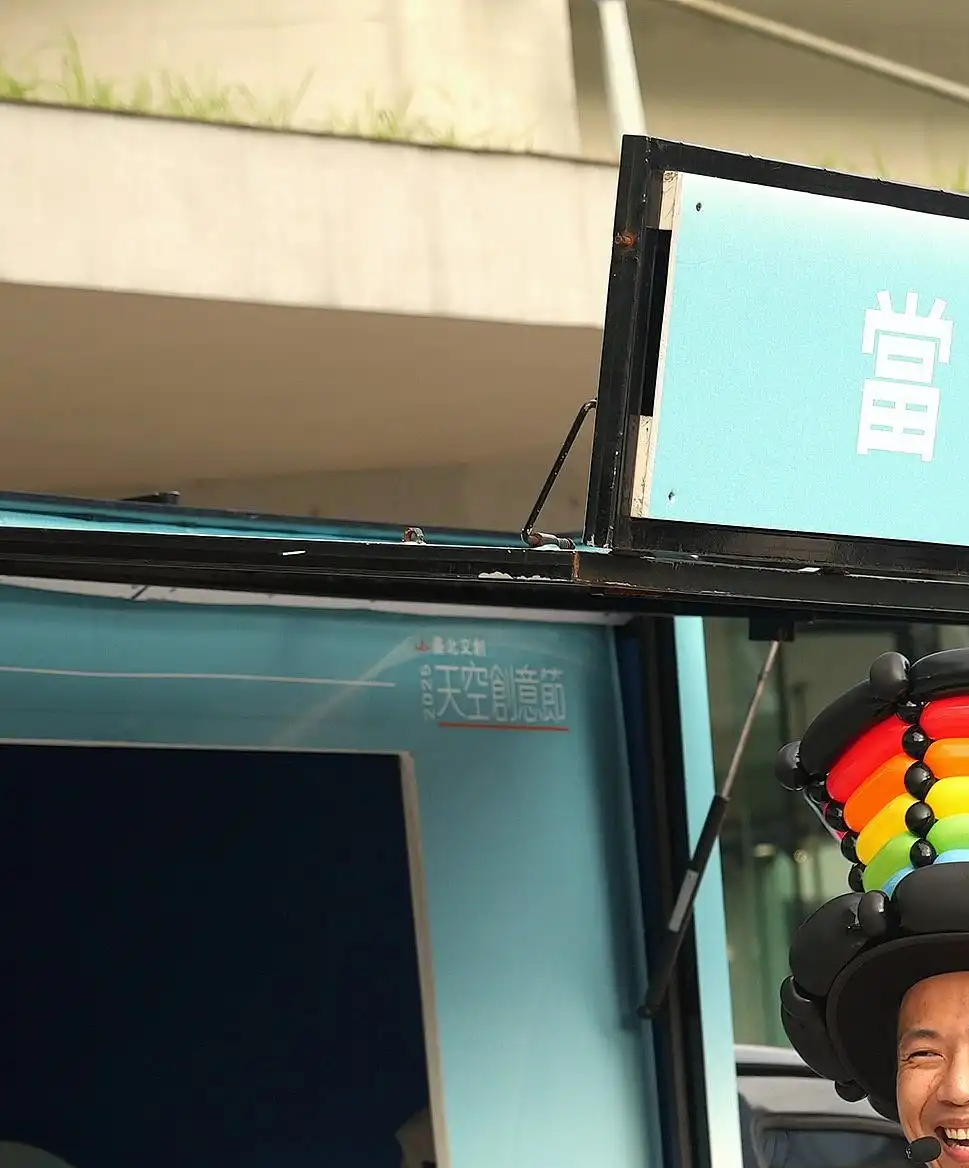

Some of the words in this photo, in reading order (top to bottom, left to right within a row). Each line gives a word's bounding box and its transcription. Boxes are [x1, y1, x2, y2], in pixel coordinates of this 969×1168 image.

[857, 290, 954, 462] 當
[436, 661, 566, 722] 天空創意節
